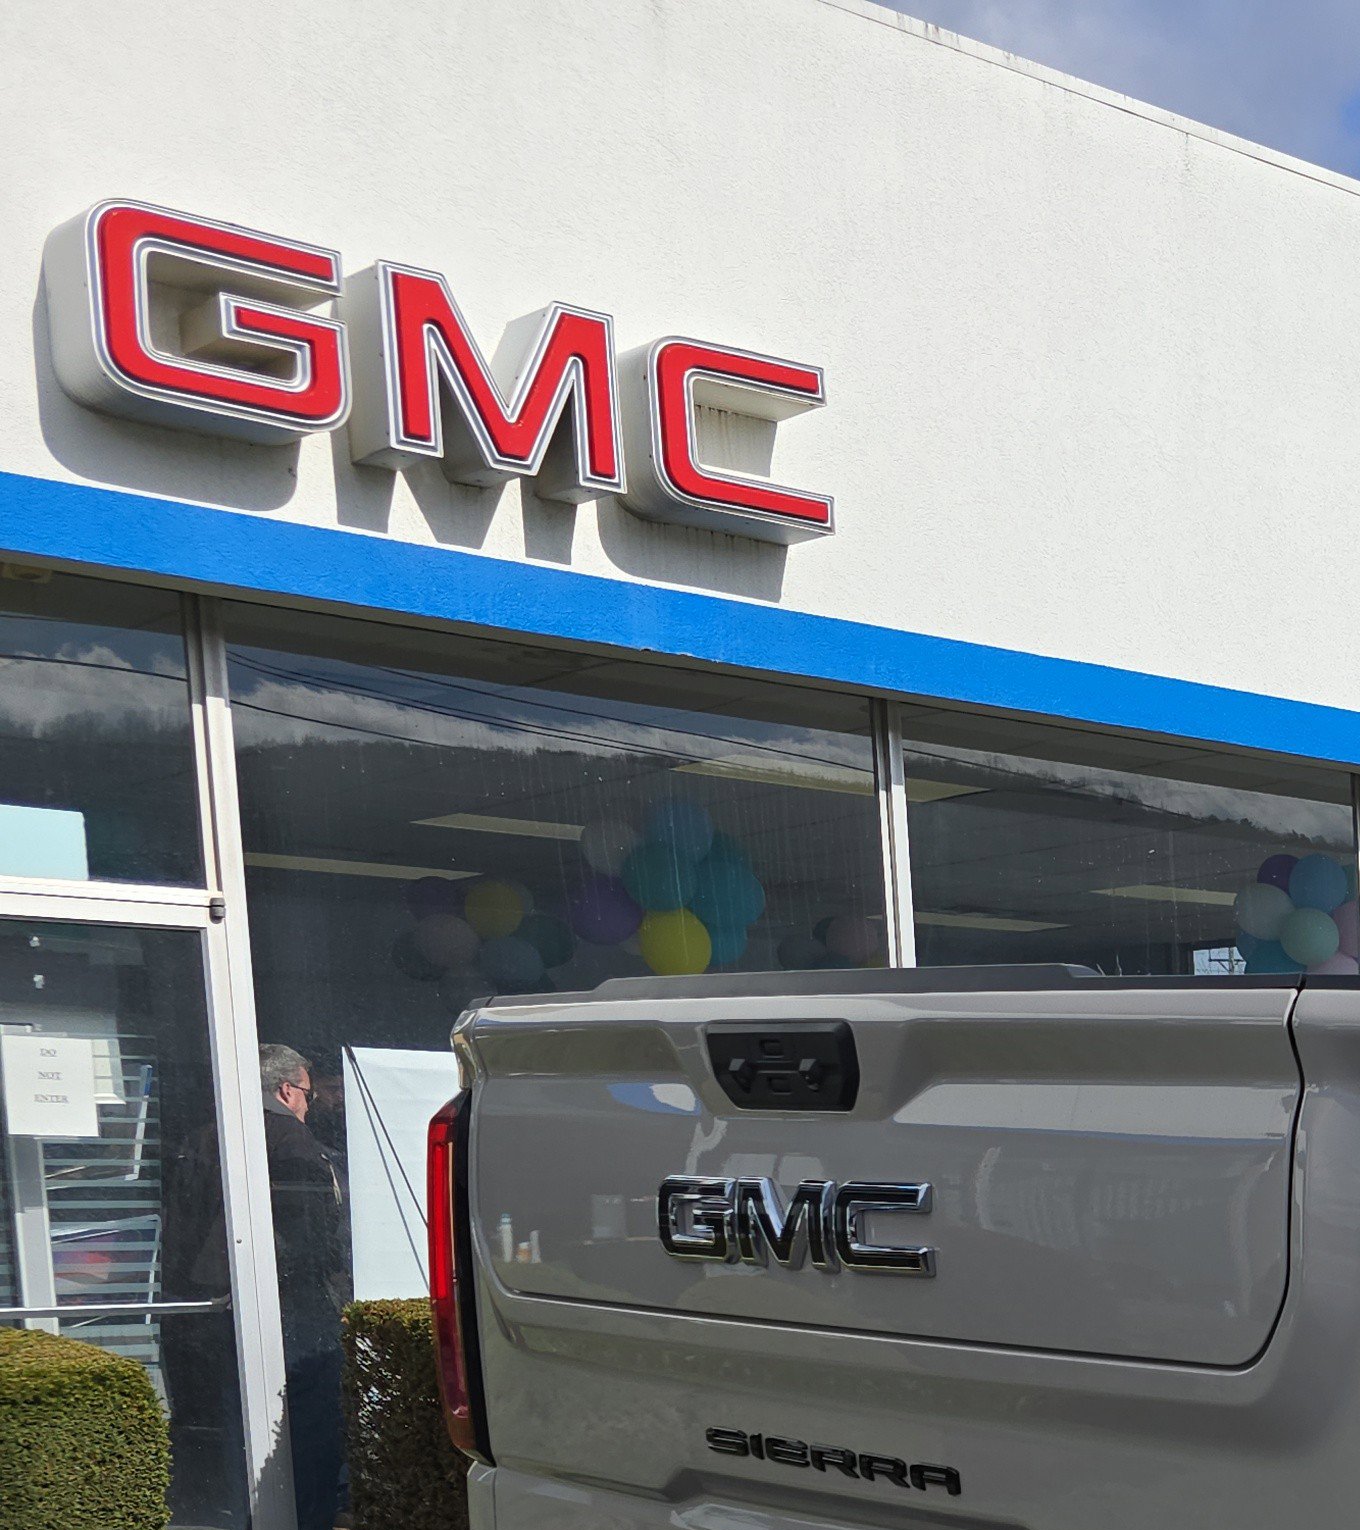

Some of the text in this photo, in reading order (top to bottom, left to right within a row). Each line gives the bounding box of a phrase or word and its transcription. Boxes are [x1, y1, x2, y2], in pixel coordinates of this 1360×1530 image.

[84, 197, 836, 538] GMC
[40, 1048, 58, 1057] DO
[38, 1071, 63, 1080] NOT
[33, 1094, 69, 1103] ENTER
[655, 1173, 937, 1278] GMC
[704, 1425, 963, 1496] SIERRA
